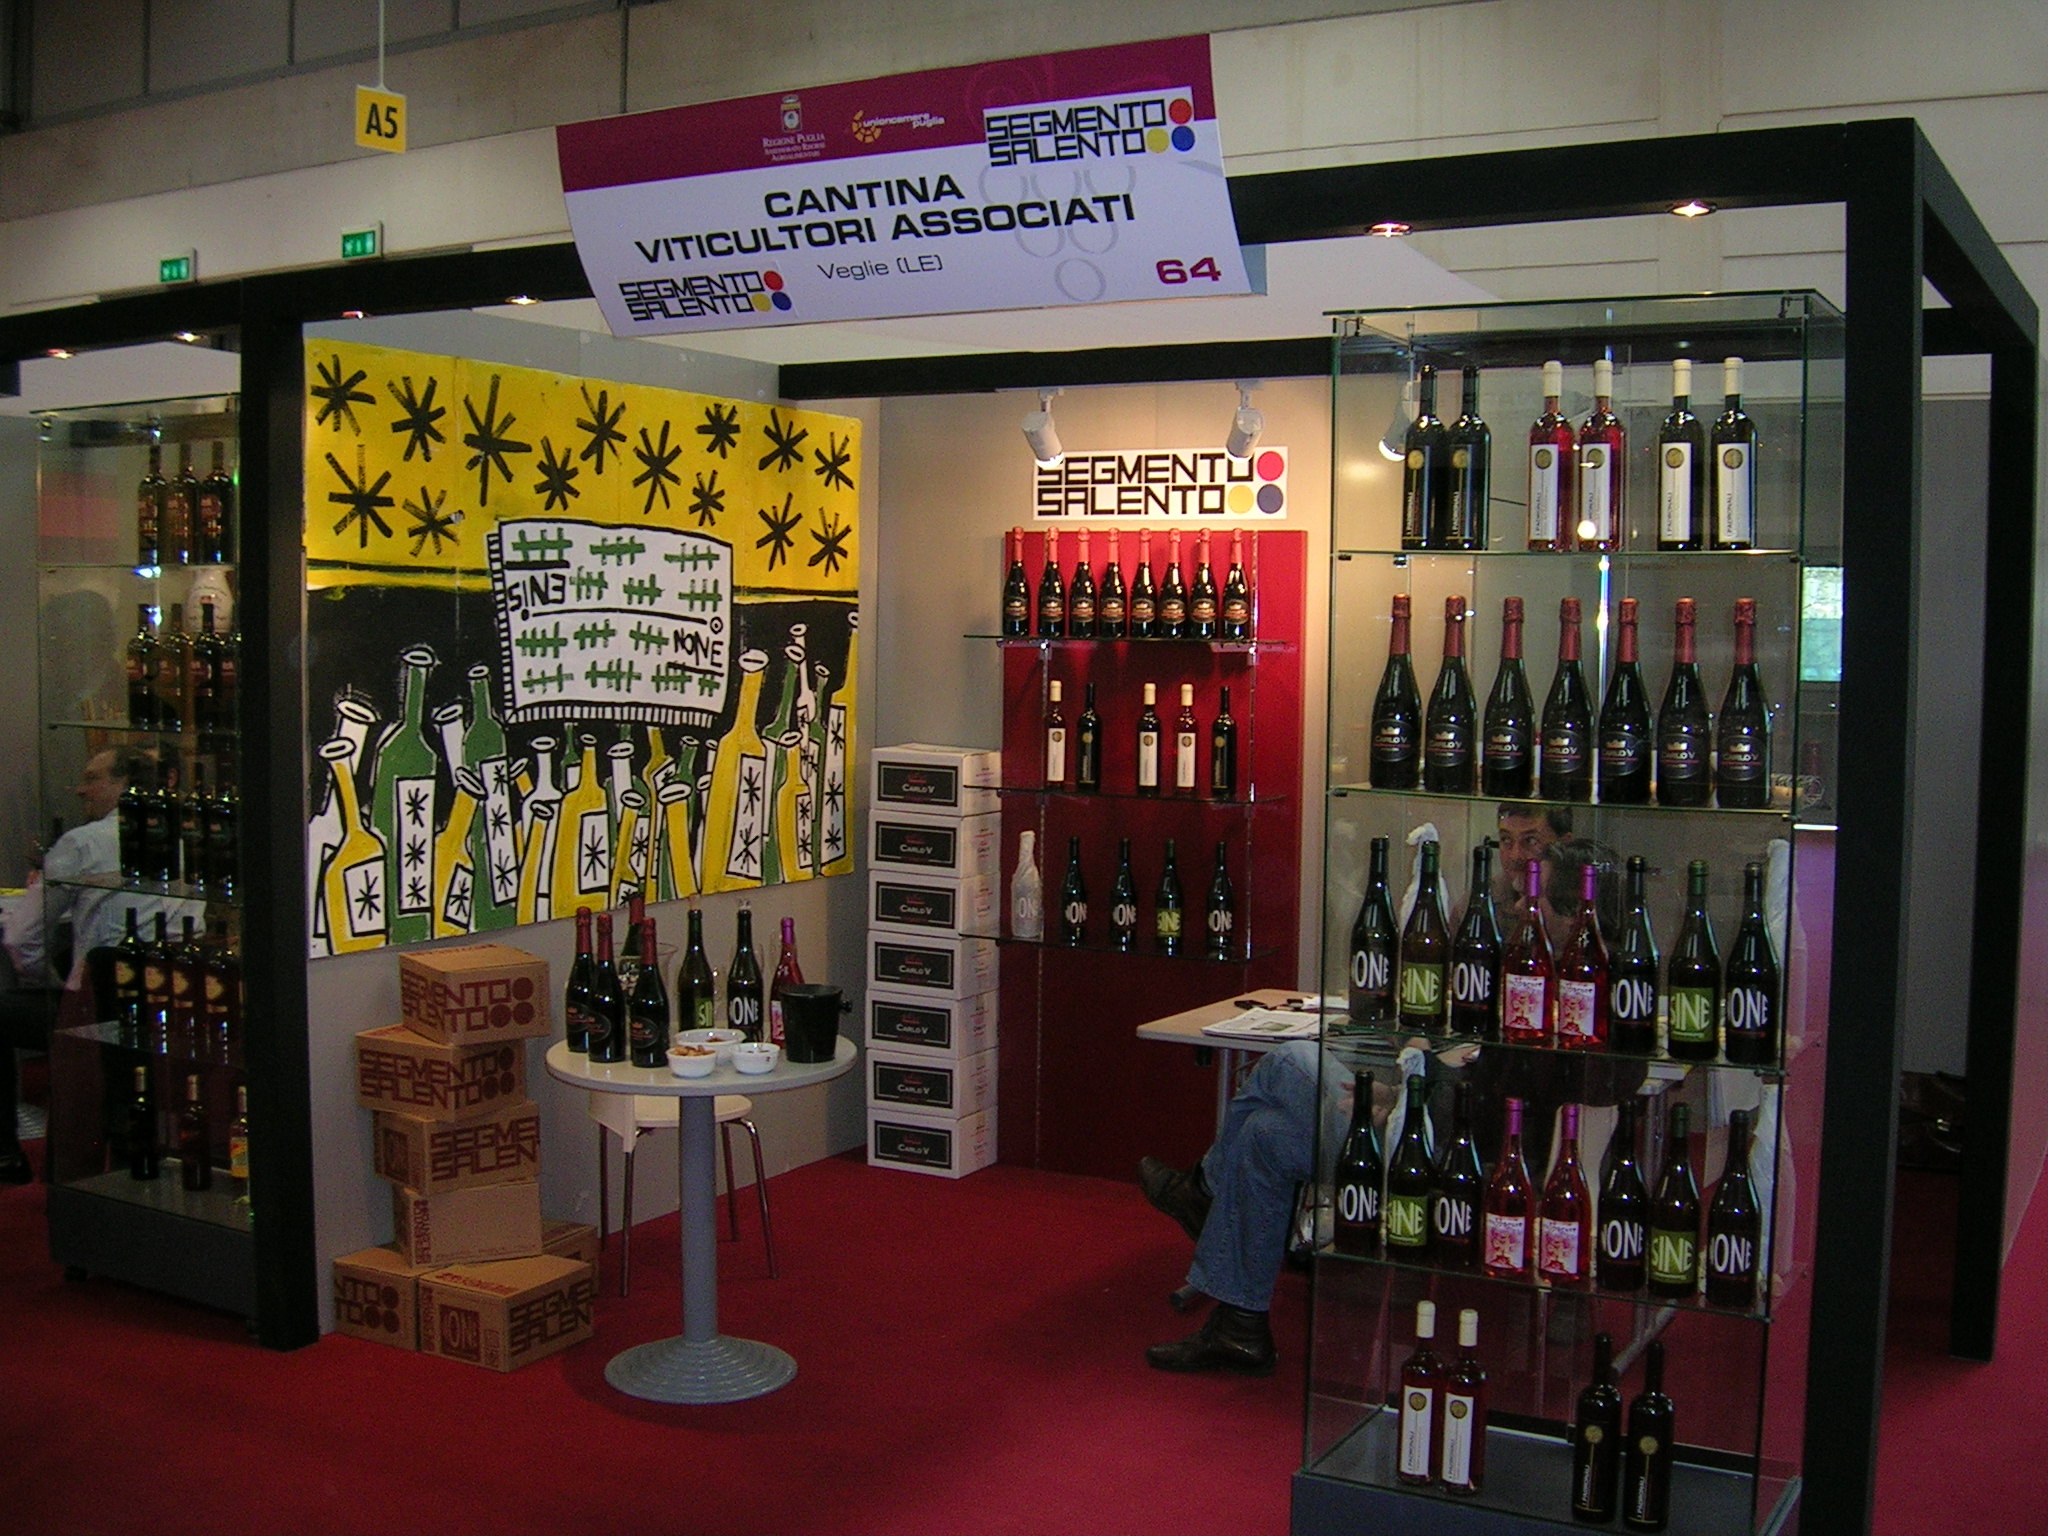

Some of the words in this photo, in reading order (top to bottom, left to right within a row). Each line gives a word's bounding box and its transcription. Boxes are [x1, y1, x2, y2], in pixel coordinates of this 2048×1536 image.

[365, 102, 399, 140] A5
[986, 99, 1167, 141] SEGMENTO
[988, 128, 1146, 167] SALENTO
[764, 174, 965, 218] CANTINA
[634, 217, 877, 263] VITICULTORI
[891, 193, 1135, 240] ASSOCIATI
[818, 260, 888, 281] Veglie
[897, 254, 944, 274] (LE)
[1156, 257, 1221, 285] 64
[618, 270, 764, 300] SEGMENTO
[627, 292, 755, 321] SALENTO
[1037, 485, 1225, 516] SALENTO
[673, 628, 724, 668] NONE
[902, 783, 927, 793] CARLO
[900, 844, 926, 854] CARLO
[900, 904, 925, 914] CARLO
[925, 907, 933, 915] V
[899, 965, 923, 975] CARLO
[924, 967, 932, 975] V
[896, 1023, 921, 1033] CARLO
[922, 1026, 929, 1034] V
[897, 1084, 922, 1094] CARLO
[923, 1087, 930, 1095] V
[897, 1143, 922, 1154] CARLO
[923, 1147, 930, 1155] V
